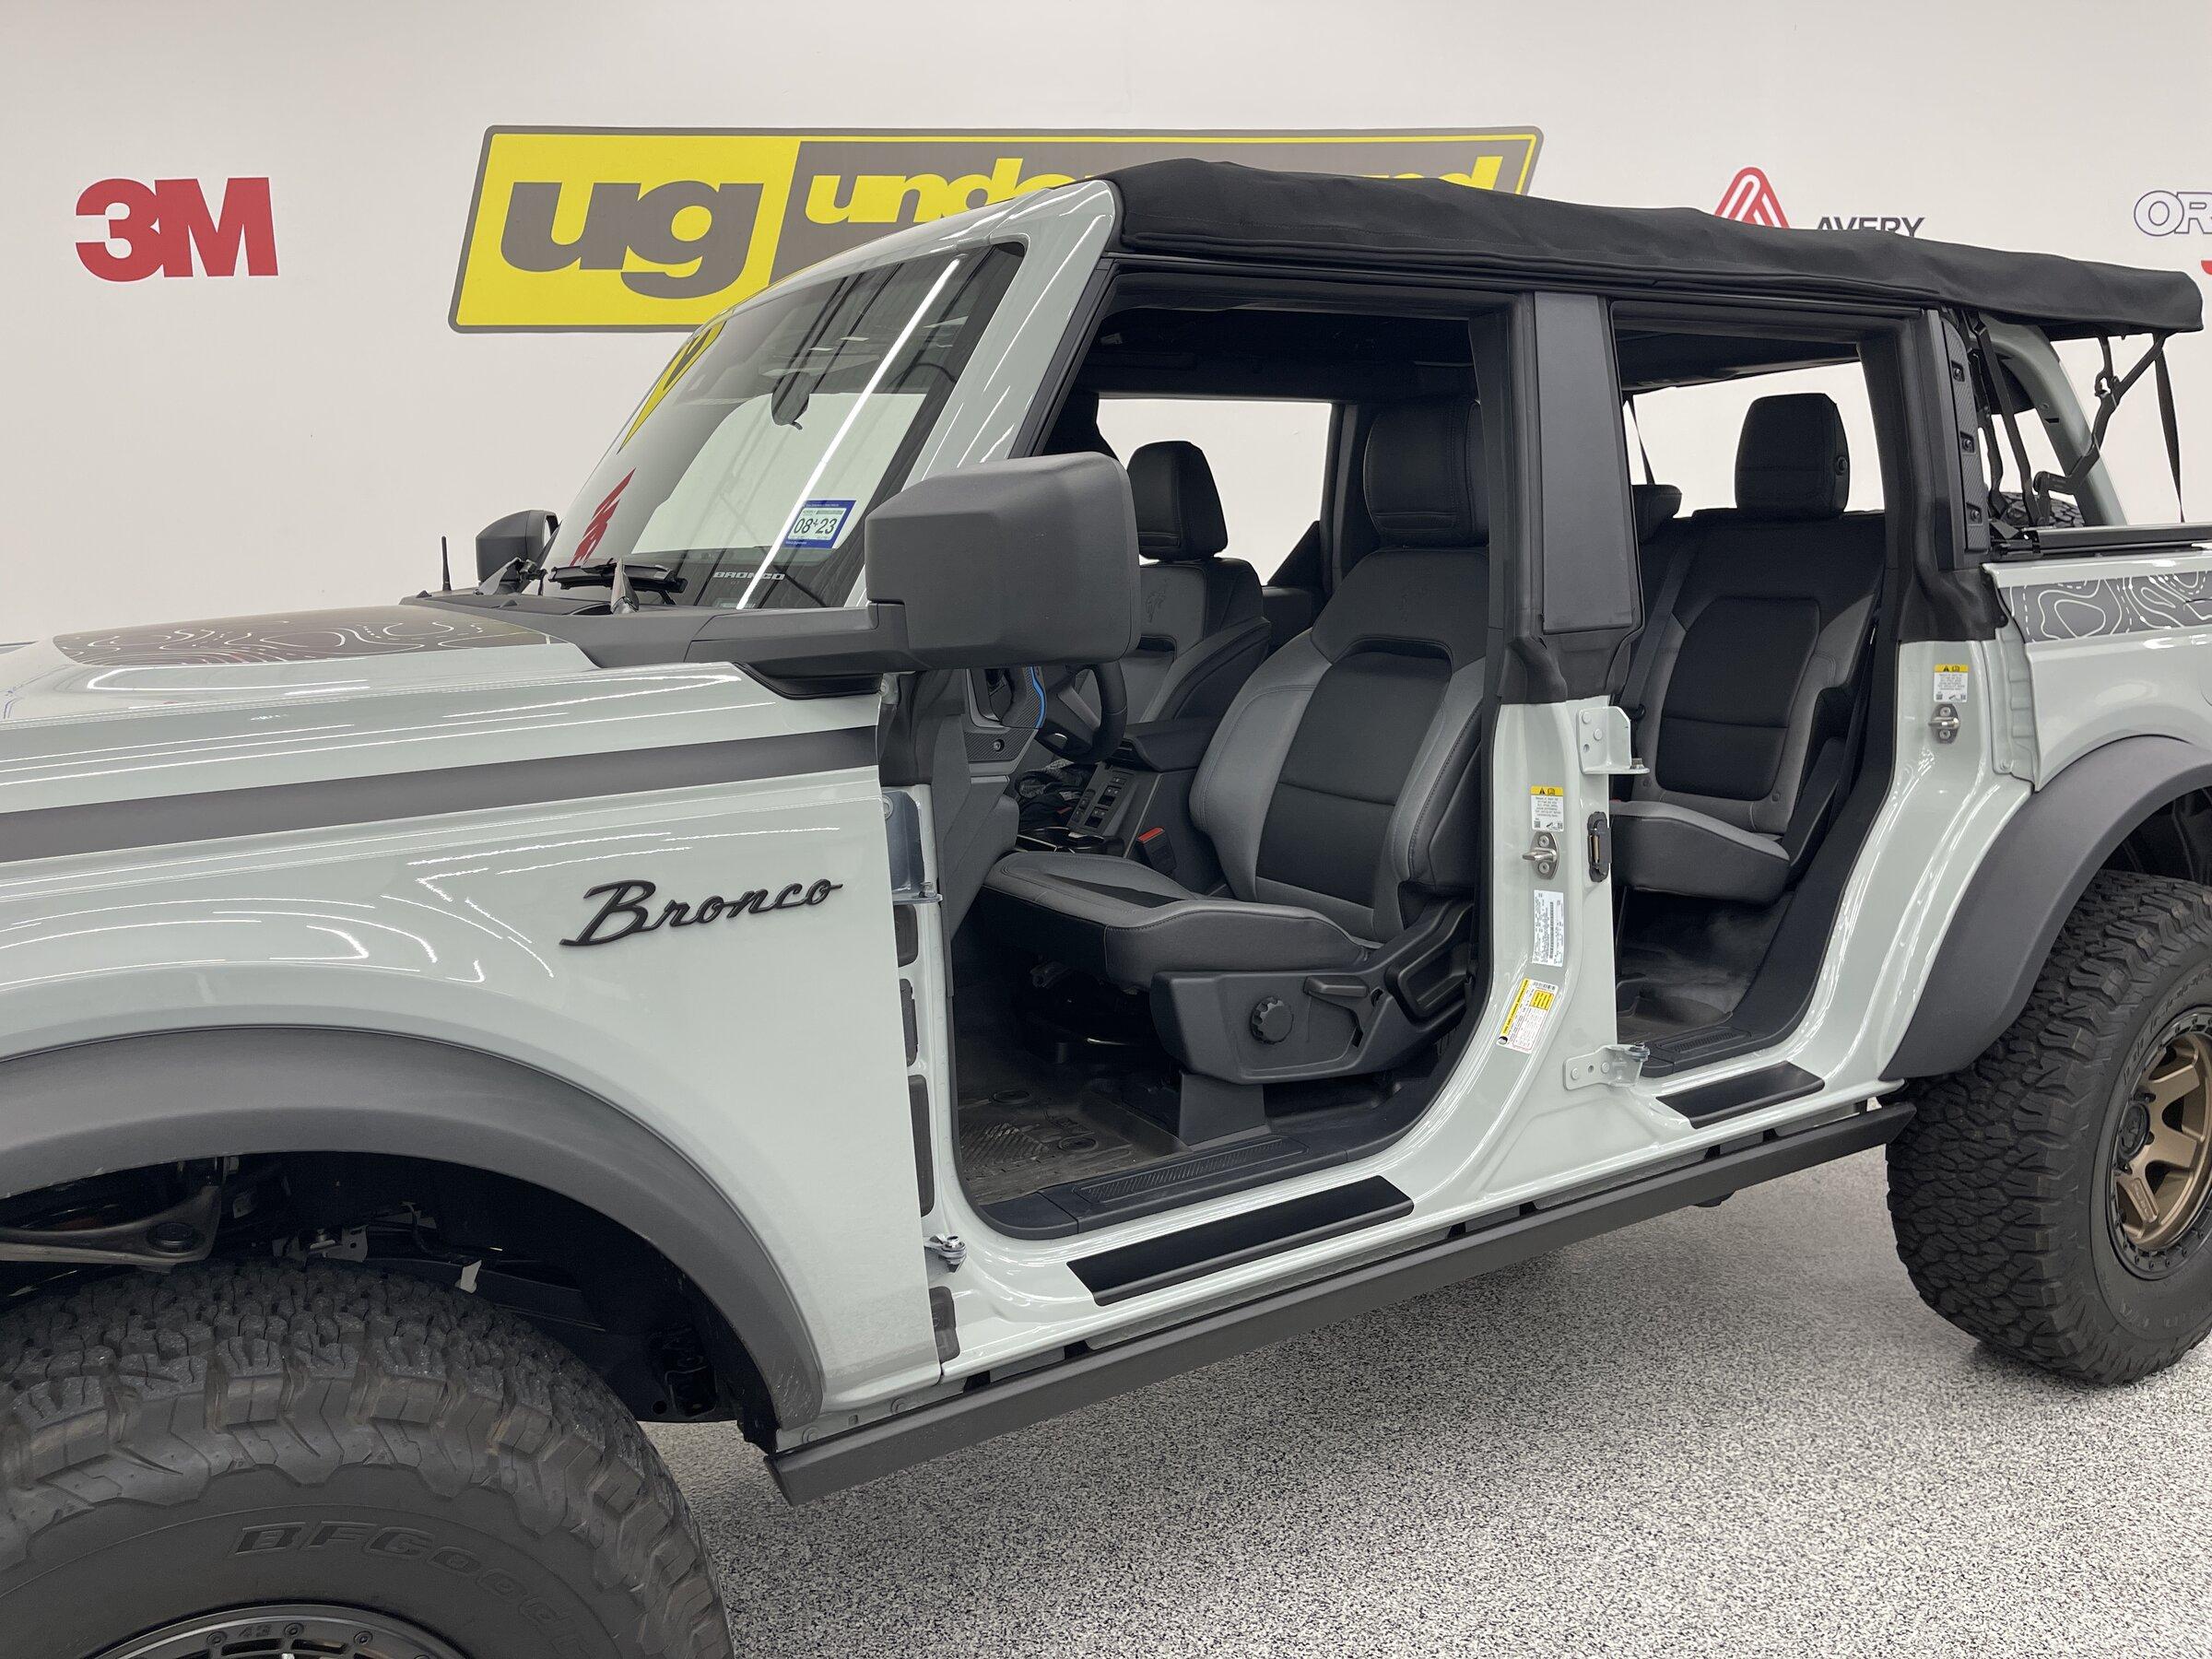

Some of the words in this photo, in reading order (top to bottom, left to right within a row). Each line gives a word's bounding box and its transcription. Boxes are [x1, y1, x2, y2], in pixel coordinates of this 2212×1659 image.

[75, 177, 279, 282] 3M
[500, 180, 764, 300] ug
[559, 878, 843, 947] Bronco
